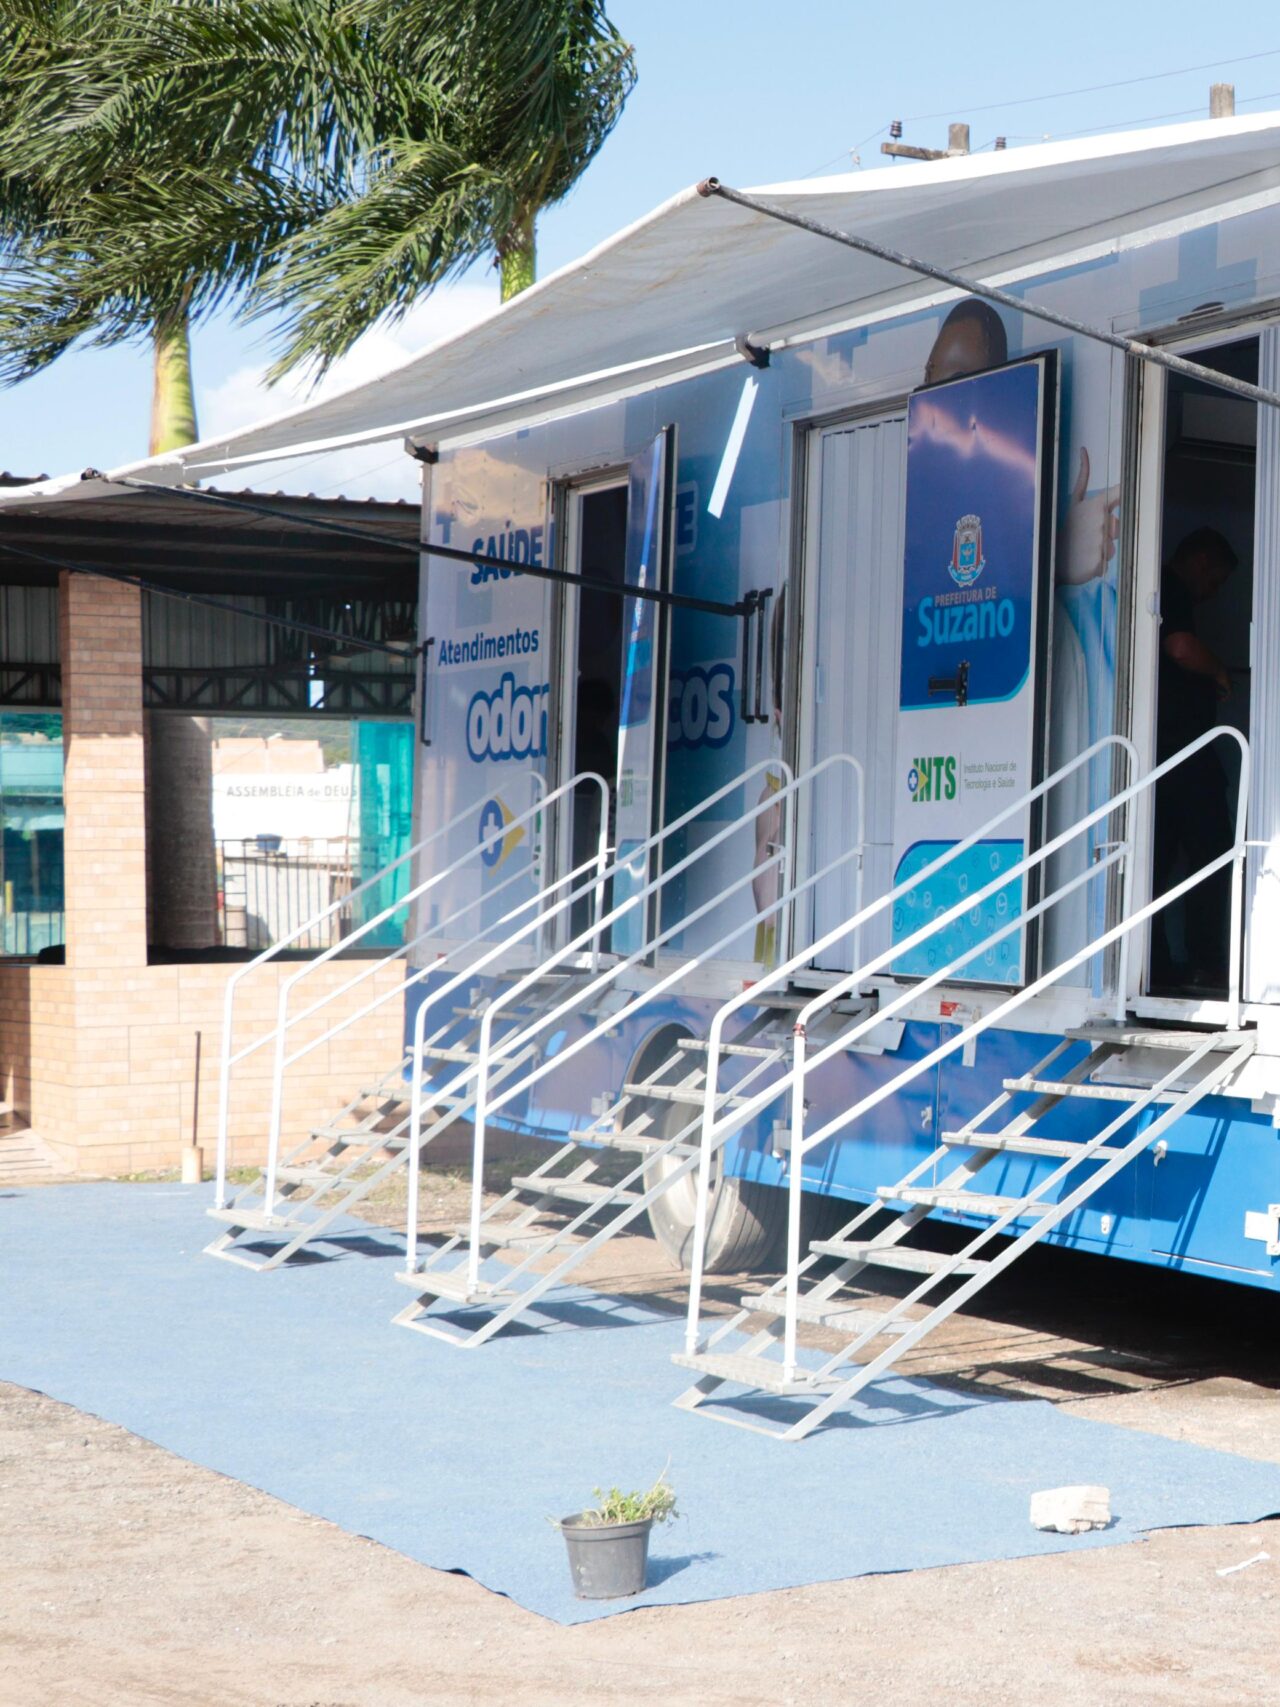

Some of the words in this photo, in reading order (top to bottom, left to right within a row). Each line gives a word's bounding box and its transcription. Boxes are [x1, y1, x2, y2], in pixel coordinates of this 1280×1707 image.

[471, 520, 543, 585] SAÚDE
[935, 588, 983, 607] PREFEITURA
[985, 586, 997, 599] DE
[917, 596, 1015, 647] Suzano
[438, 628, 539, 667] Atendimentos
